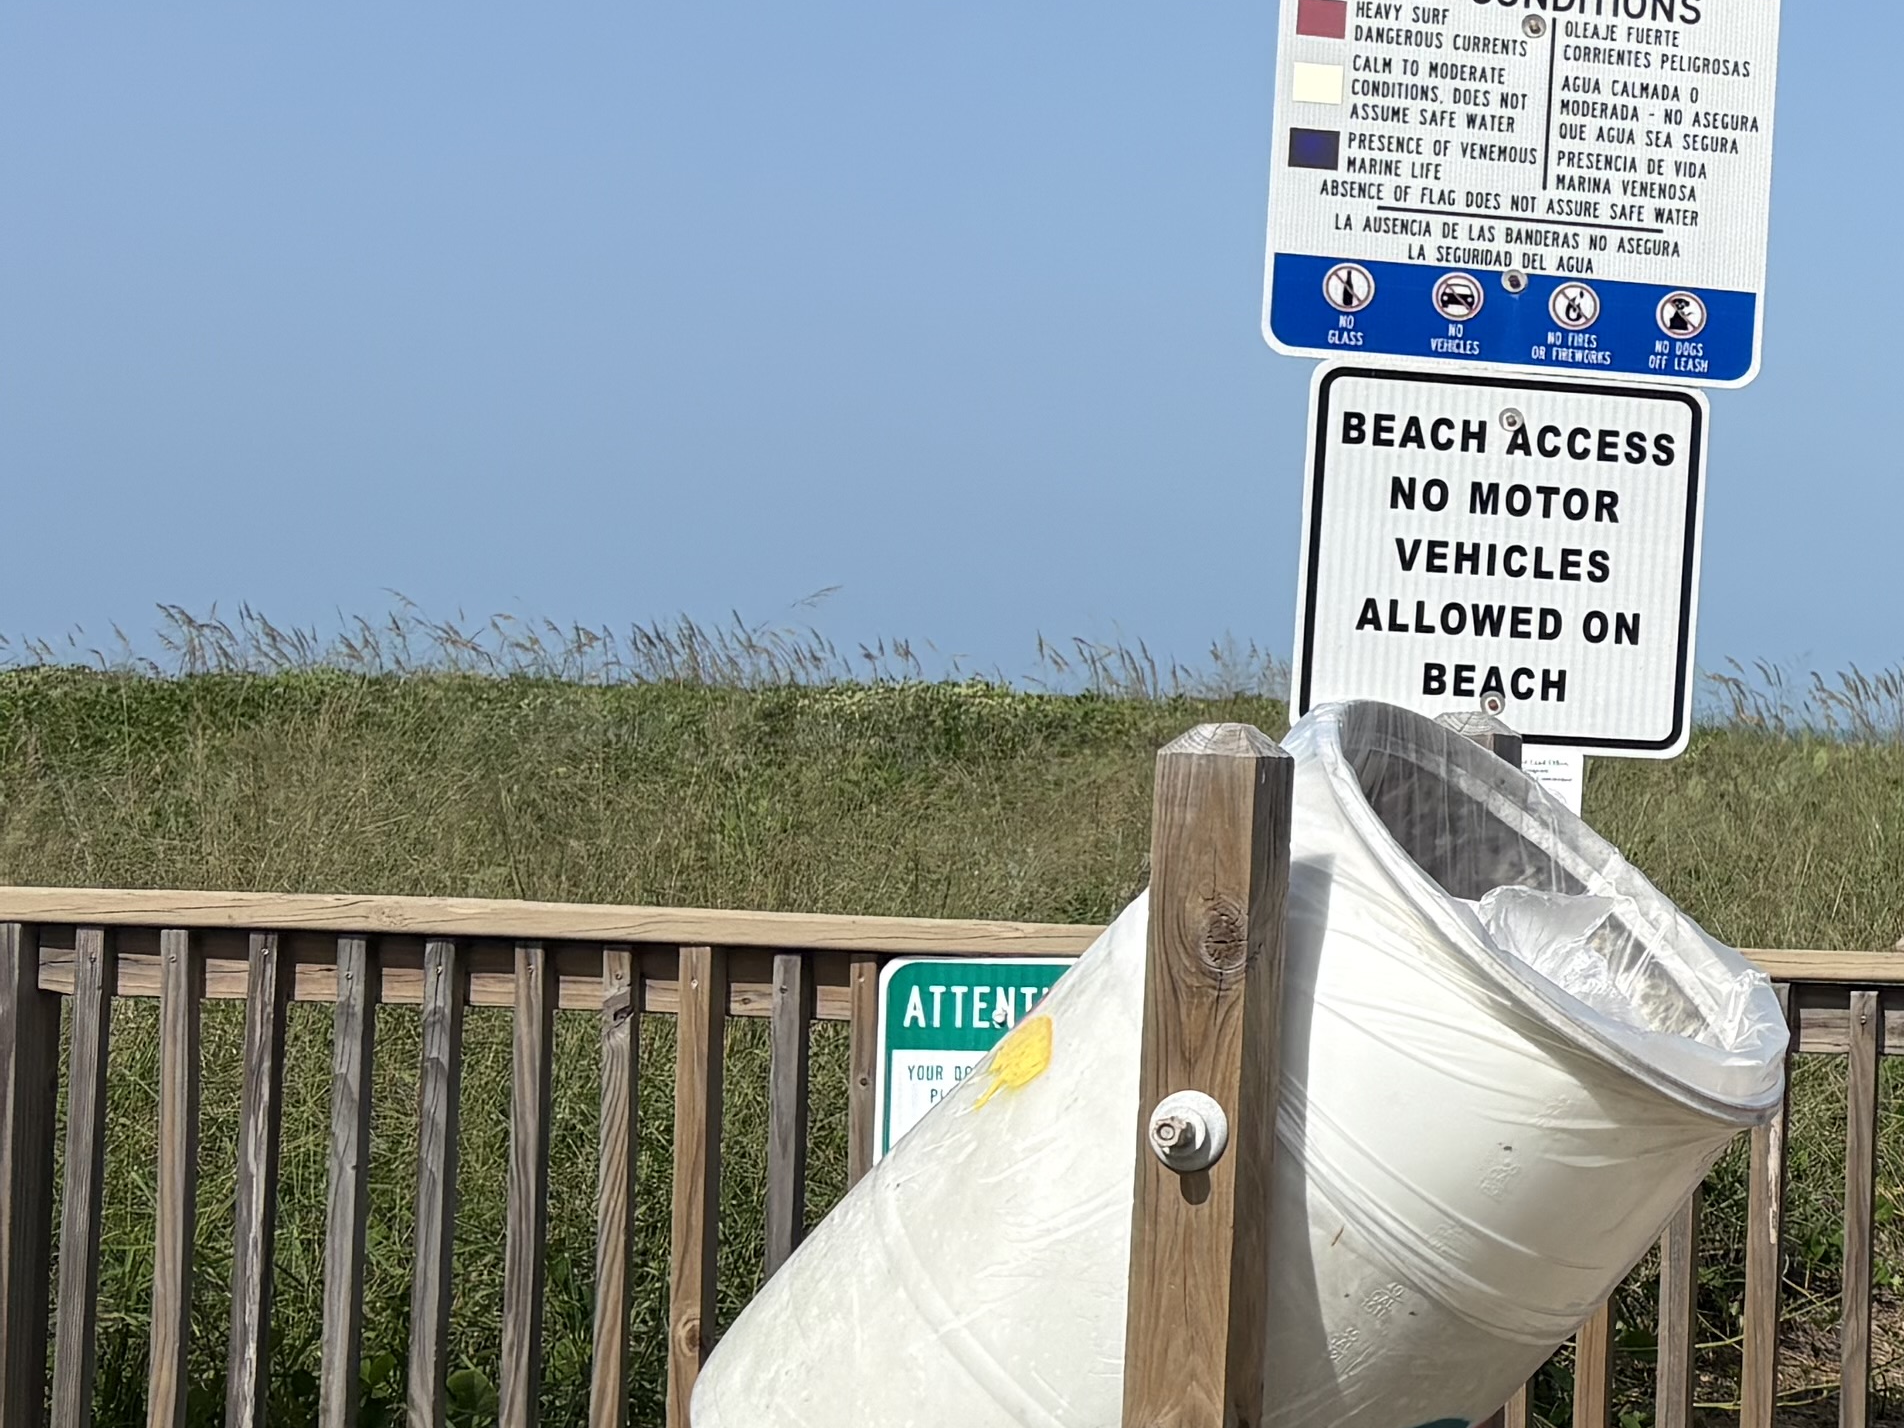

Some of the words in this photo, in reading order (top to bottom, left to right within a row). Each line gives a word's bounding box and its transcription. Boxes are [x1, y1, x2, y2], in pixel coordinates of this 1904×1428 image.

[1355, 0, 1402, 21] HEAVY
[1411, 6, 1450, 26] SURF
[1354, 24, 1444, 49] DANGEROUS
[1453, 33, 1528, 58] CURRENTS
[1564, 20, 1618, 42] OLEAJE
[1627, 25, 1681, 48] FUERTE
[1352, 54, 1393, 74] CALM
[1402, 59, 1419, 77] TO
[1428, 61, 1506, 85] MODERATE
[1563, 44, 1652, 69] CORRIENTES
[1660, 53, 1751, 78] PELIGROSAS
[1452, 87, 1491, 107] DOES
[1500, 92, 1528, 111] NOT
[1561, 75, 1601, 95] AGUA
[1611, 79, 1681, 102] CALMADA
[1690, 87, 1699, 104] O
[1350, 103, 1410, 124] ASSUME
[1419, 108, 1457, 128] SAFE
[1466, 113, 1515, 133] WATER
[1559, 99, 1640, 123] MODERADA
[1664, 108, 1683, 126] NO
[1692, 111, 1759, 133] ASEGURA
[1347, 131, 1424, 155] PRESENCE
[1433, 139, 1451, 157] OF
[1460, 141, 1538, 165] VENEMOUS
[1559, 122, 1587, 141] QUE
[1596, 126, 1635, 145] AGUA
[1645, 130, 1673, 149] SEA
[1682, 133, 1739, 155] SEGURA
[1346, 156, 1402, 178] MARINE
[1411, 161, 1443, 181] LIFE
[1556, 150, 1638, 174] PRESENCIA
[1647, 158, 1665, 176] DE
[1674, 160, 1707, 180] VIDA
[1319, 178, 1385, 201] ABSENCE
[1393, 185, 1411, 203] OF
[1420, 187, 1457, 206] FLAG
[1465, 190, 1501, 210] DOES
[1510, 194, 1537, 214] NOT
[1545, 198, 1600, 219] ASSURE
[1609, 203, 1645, 223] SAFE
[1654, 206, 1699, 227] WATER
[1555, 173, 1612, 195] MARINA
[1621, 179, 1697, 202] VENENOSA
[1334, 213, 1353, 231] LA
[1362, 215, 1432, 238] AUSENCIA
[1442, 222, 1459, 240] DE
[1468, 223, 1496, 243] LAS
[1504, 227, 1580, 250] BANDERAS
[1588, 234, 1608, 252] NO
[1617, 237, 1681, 259] ASEGURA
[1407, 243, 1426, 261] LA
[1436, 245, 1513, 268] SEGURIDAD
[1522, 252, 1547, 271] DEL
[1556, 255, 1594, 275] AGUA
[1338, 314, 1355, 330] NO
[1447, 323, 1464, 339] NO
[1327, 329, 1364, 346] GLASS
[1430, 338, 1480, 356] VEHICLES
[1546, 331, 1562, 346] NO
[1567, 333, 1597, 348] FIRES
[1654, 339, 1670, 355] NO
[1675, 341, 1704, 356] DOGS
[1531, 345, 1546, 361] OR
[1552, 347, 1612, 365] FIREWORKS
[1648, 355, 1667, 371] OFF
[1674, 356, 1709, 374] LEASH
[1341, 410, 1488, 454] BEACH
[1505, 421, 1676, 467] ACCESS
[1389, 475, 1449, 513] NO
[1469, 480, 1620, 524] MOTOR
[1394, 536, 1611, 584] VEHICLES
[1354, 596, 1563, 642] ALLOWED
[1581, 609, 1641, 646] ON
[1421, 662, 1568, 703] BEACH
[908, 1065, 943, 1081] YOUR
